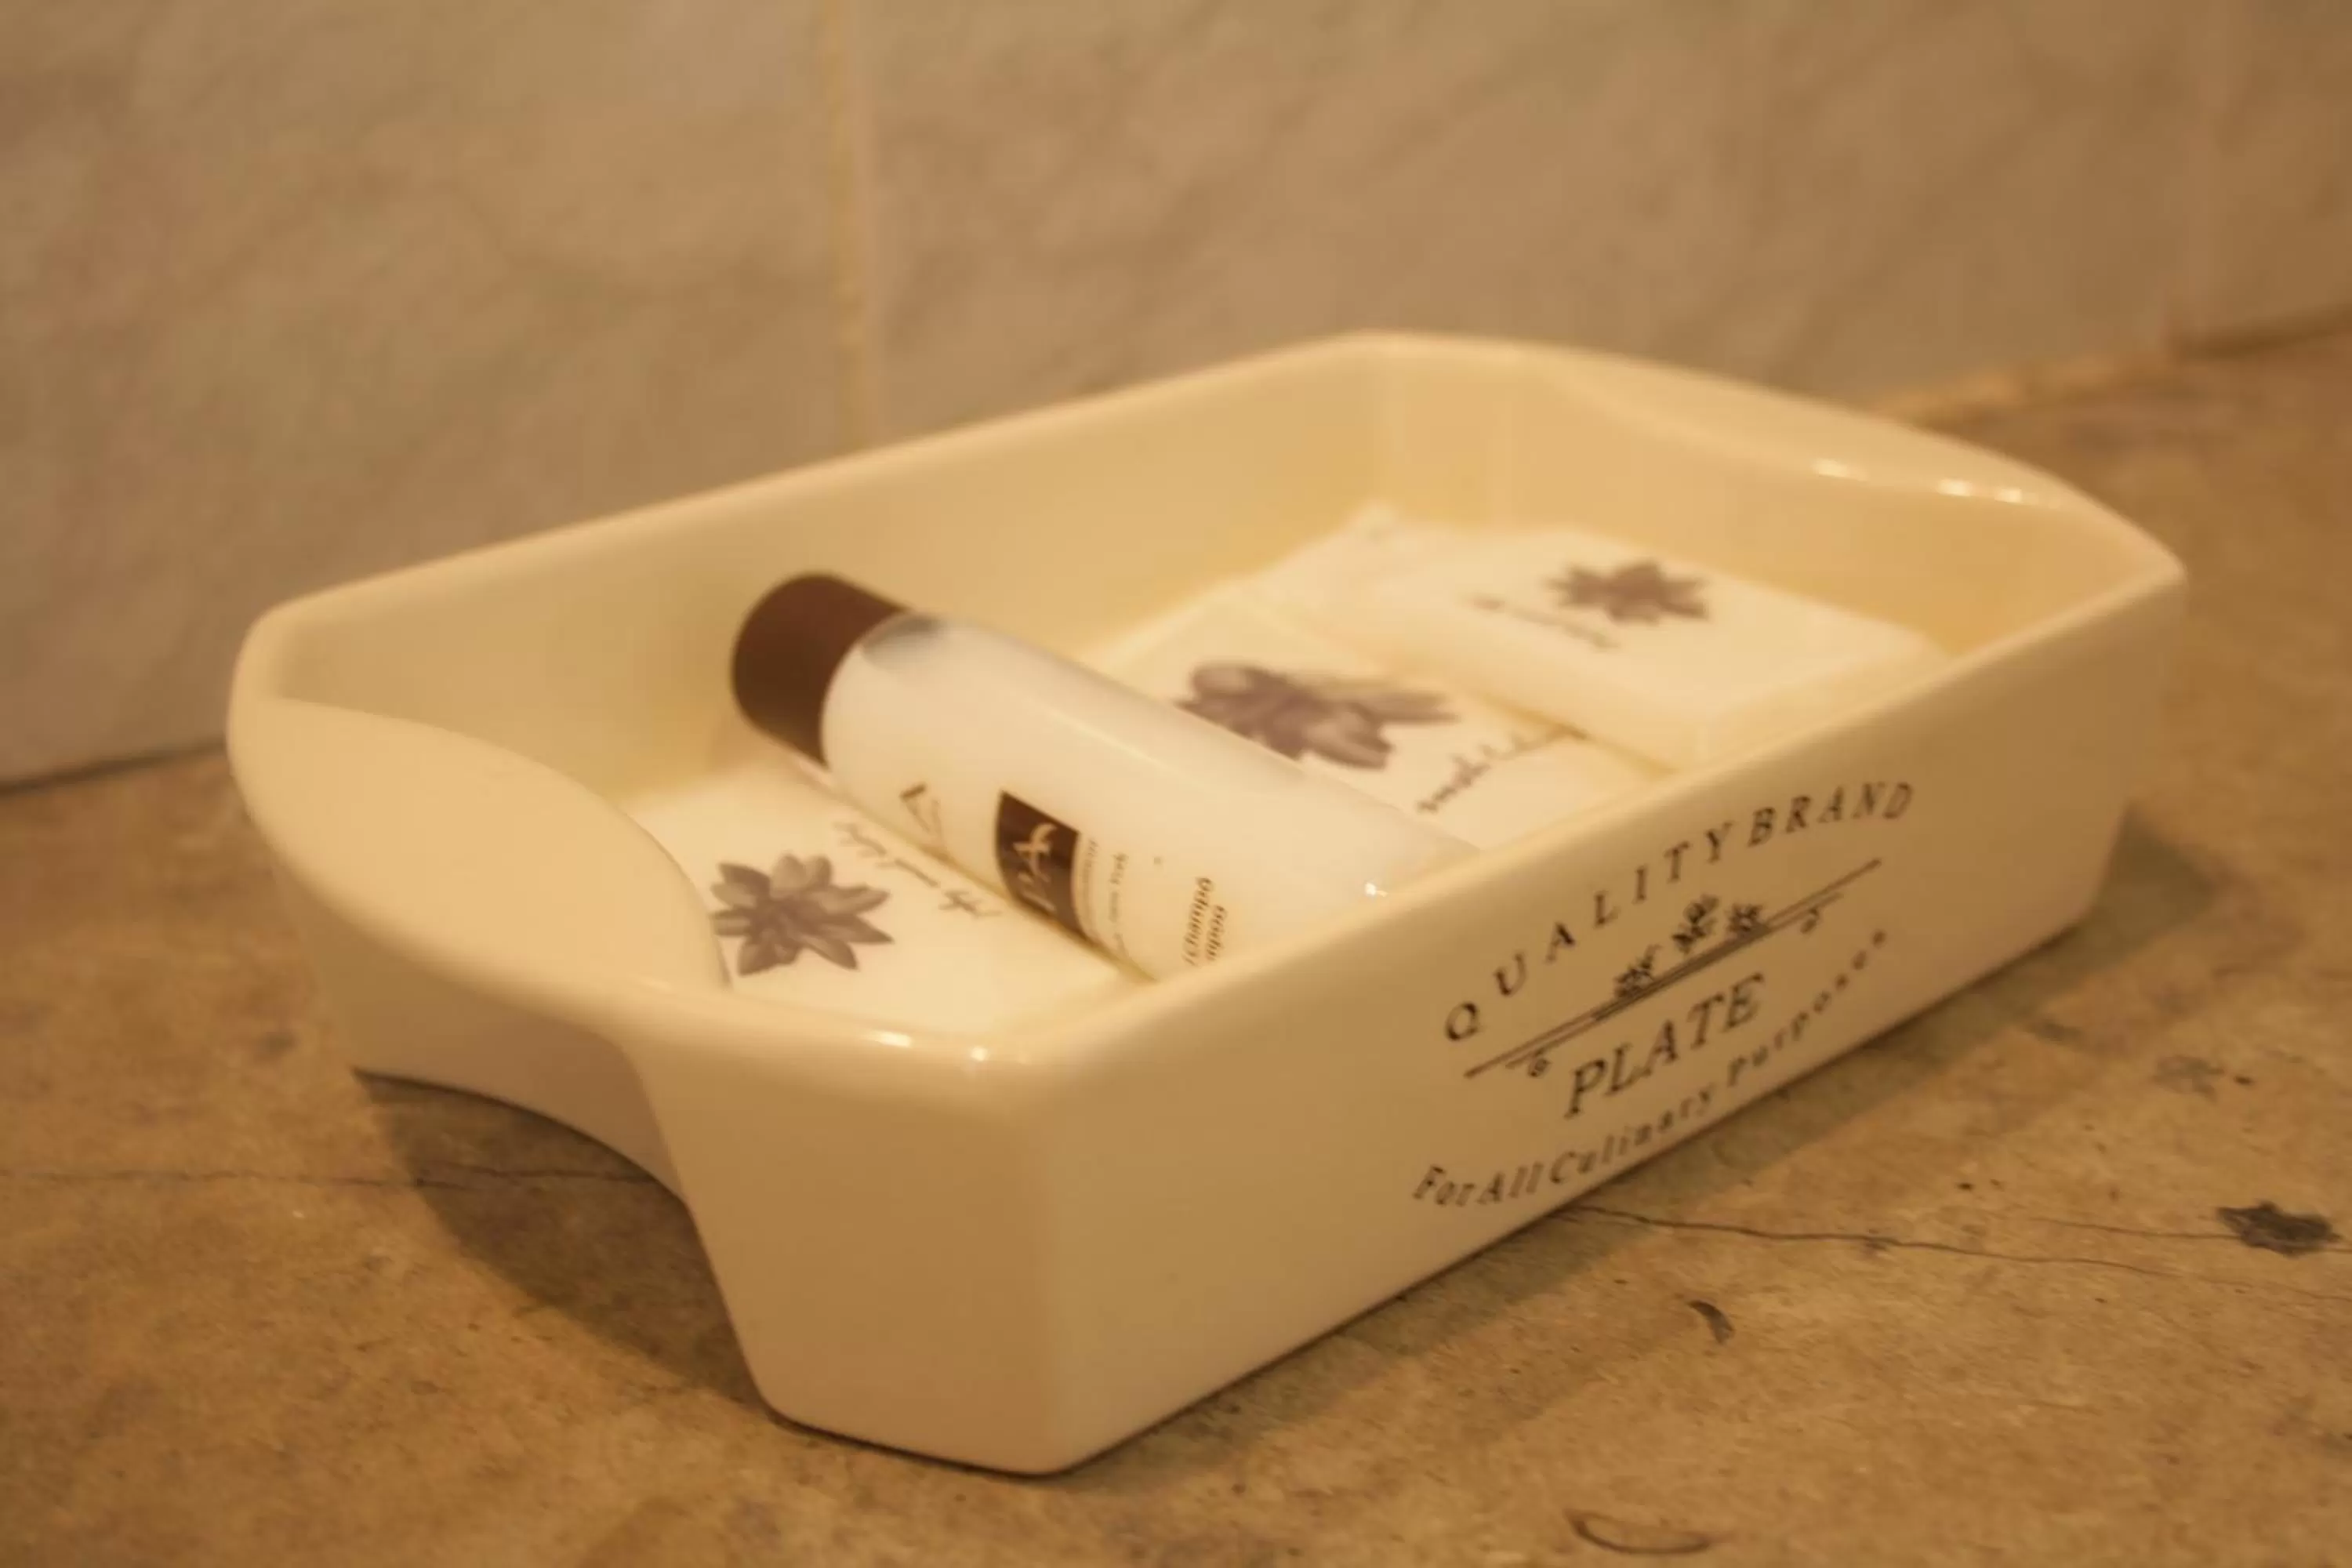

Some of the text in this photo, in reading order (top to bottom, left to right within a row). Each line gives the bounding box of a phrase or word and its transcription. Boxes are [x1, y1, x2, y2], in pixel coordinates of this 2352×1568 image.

[1444, 781, 1914, 1042] QUALITY BRAND
[1412, 927, 1887, 1207] For All Culinary Purposes
[1564, 971, 1765, 1120] PLATE
